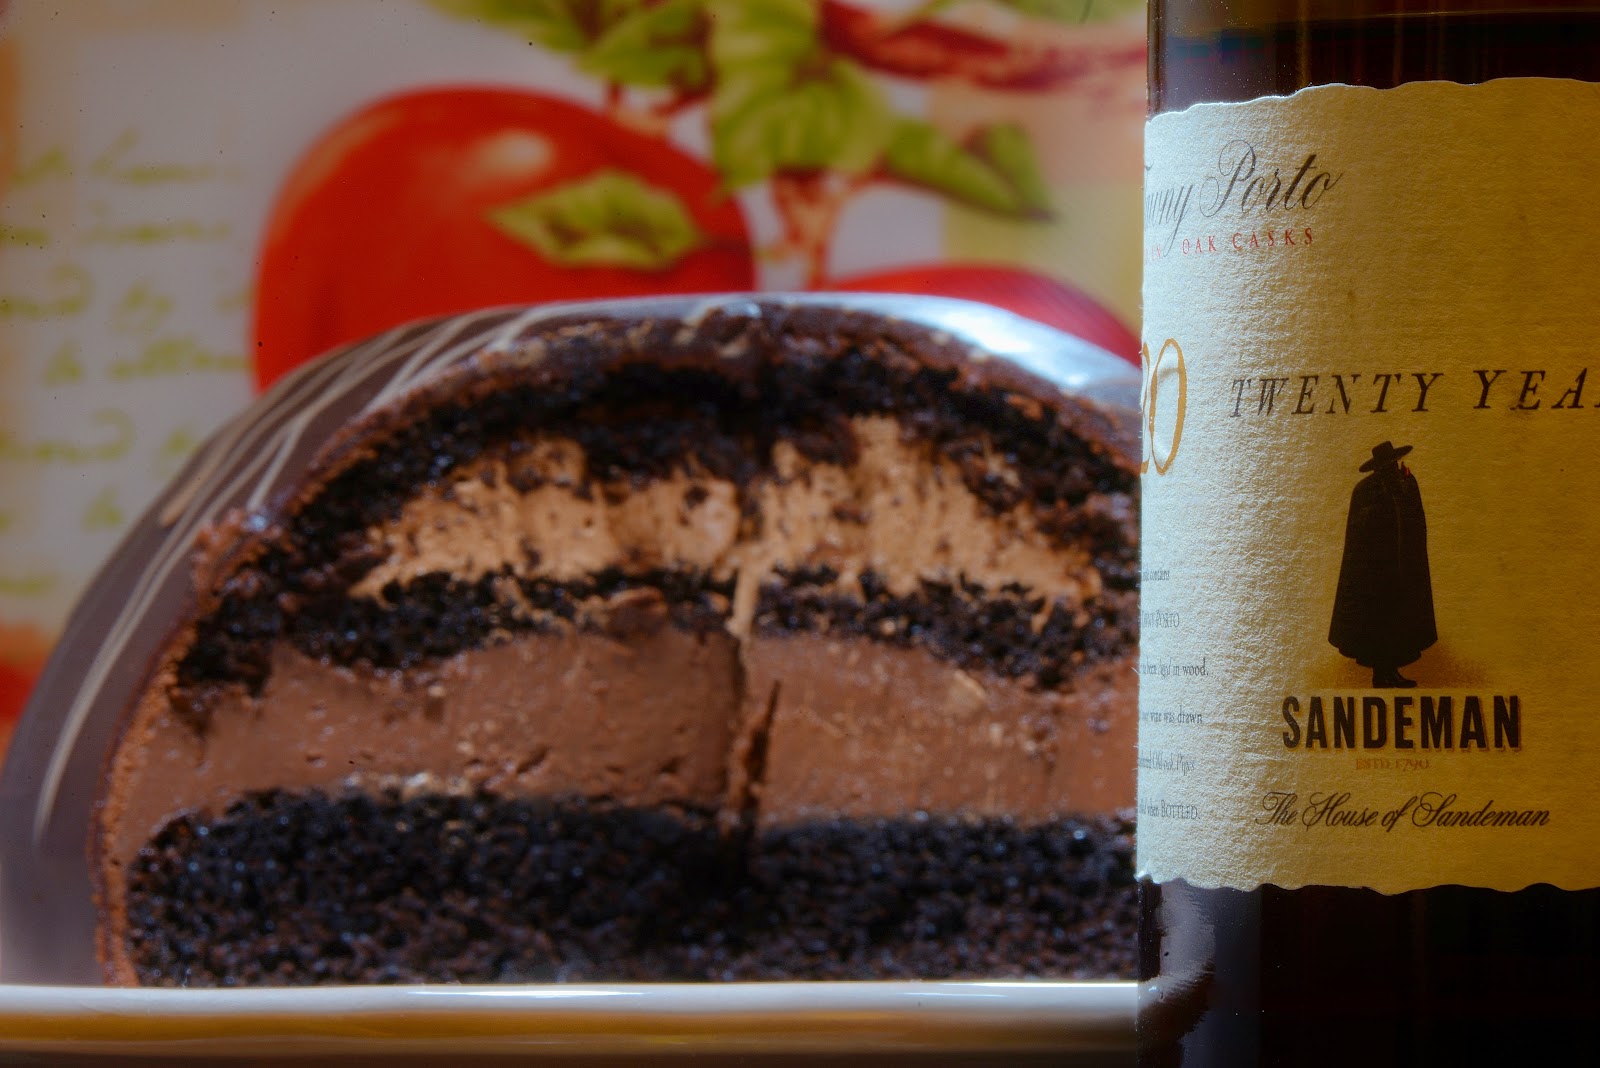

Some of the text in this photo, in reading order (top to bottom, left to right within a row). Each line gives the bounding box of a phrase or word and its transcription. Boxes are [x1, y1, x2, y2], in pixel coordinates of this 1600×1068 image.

[1199, 139, 1344, 217] Porto
[1182, 235, 1218, 255] OAK
[1232, 226, 1314, 251] CASKS
[1230, 367, 1600, 418] TWENTY YEA
[1182, 657, 1209, 676] wood.
[1281, 694, 1521, 750] SANDEMAN
[1256, 791, 1550, 833] The House of Sandeman
